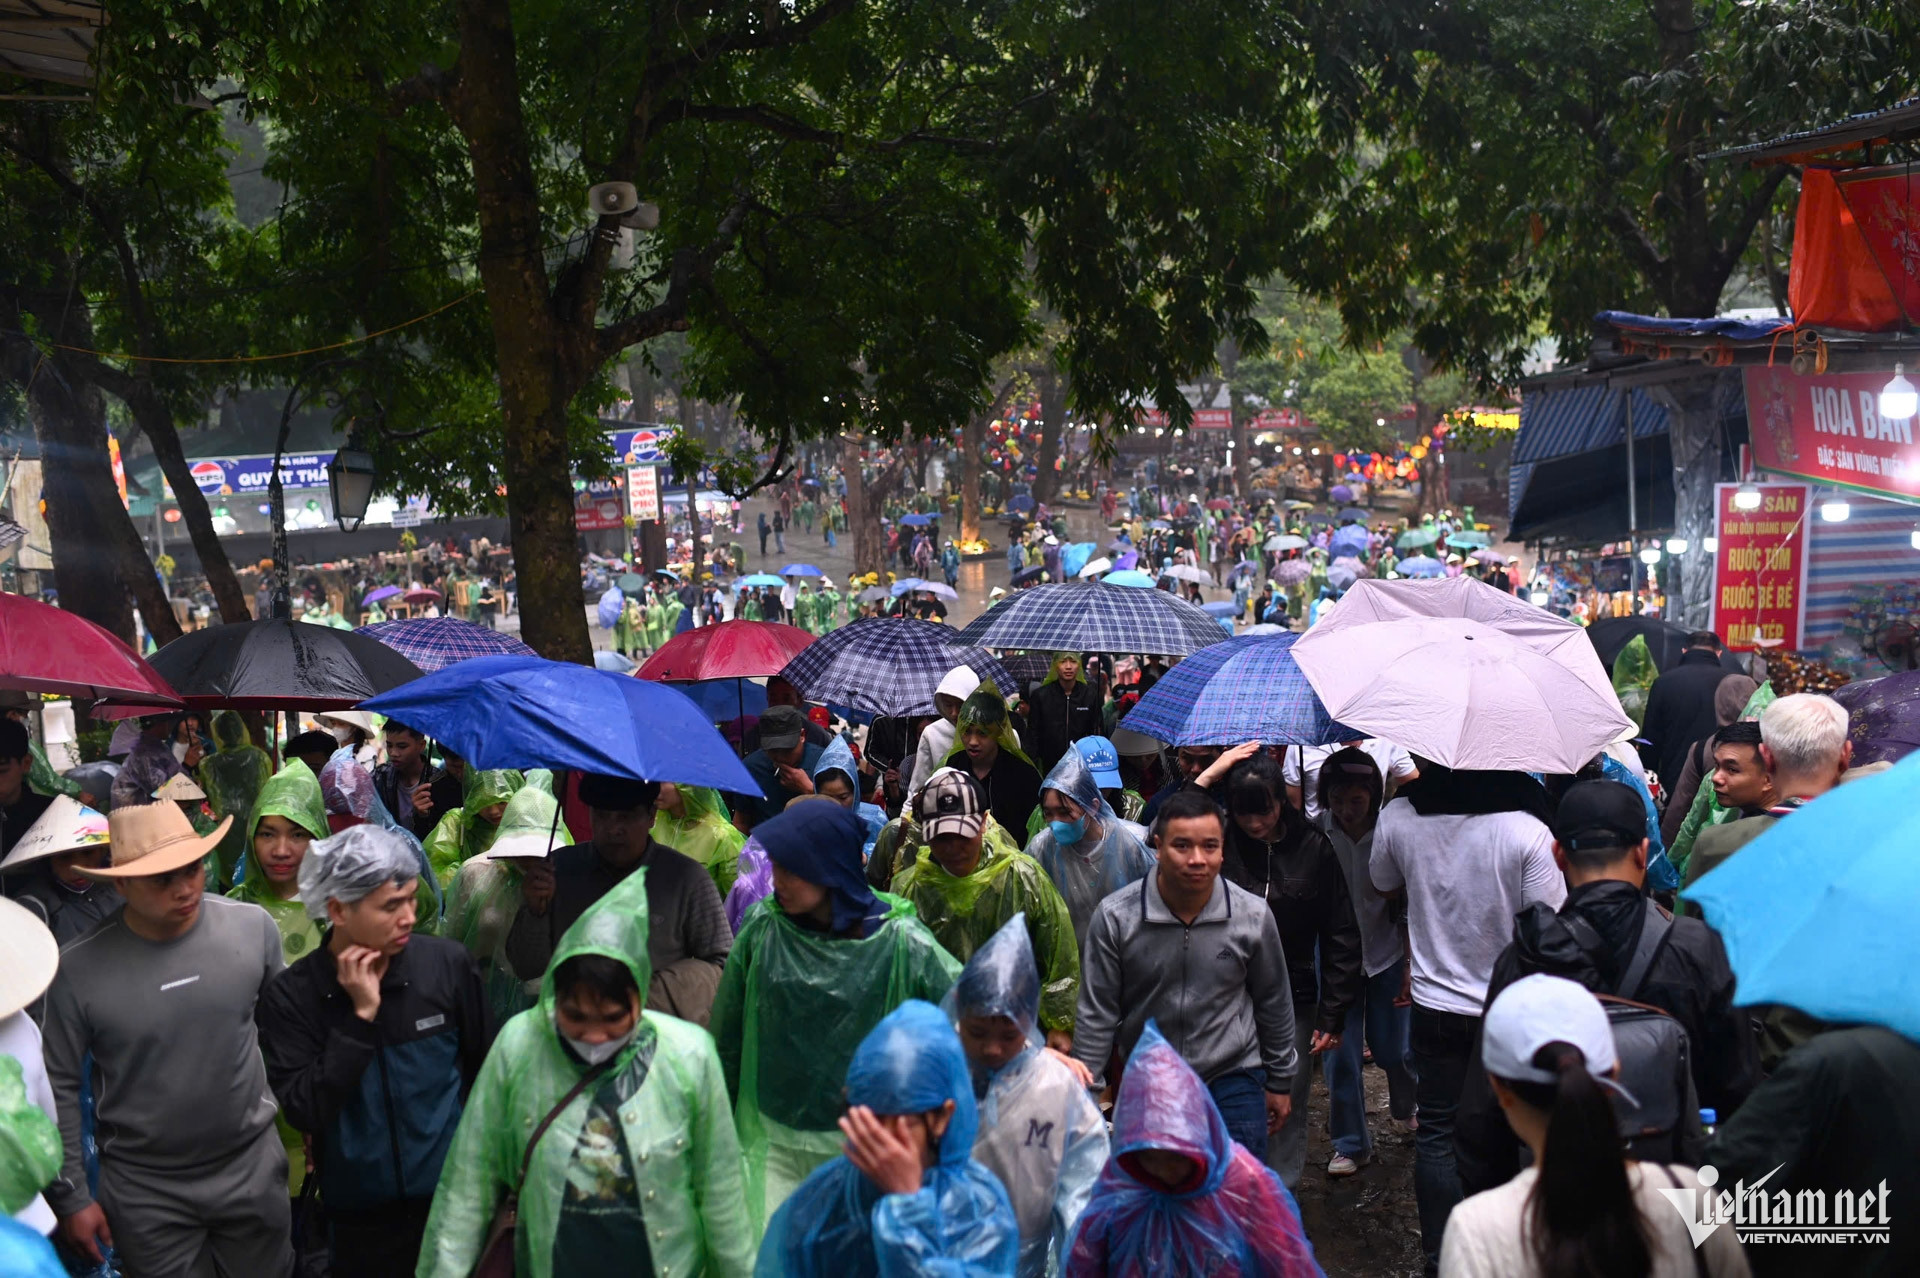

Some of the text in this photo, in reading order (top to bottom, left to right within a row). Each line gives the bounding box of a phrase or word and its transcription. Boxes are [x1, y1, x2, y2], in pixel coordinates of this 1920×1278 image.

[1809, 385, 1858, 438] HOA
[632, 442, 657, 450] PEPS
[1817, 443, 1836, 471] ĐẶC
[1836, 445, 1855, 471] SẢN
[1854, 451, 1880, 475] VÙNG
[238, 468, 294, 487] QUYT
[1764, 490, 1798, 513] SẢN
[1728, 540, 1791, 571] RUỐC TÔM
[1721, 577, 1755, 610] RUỐC
[1024, 1118, 1055, 1148] M
